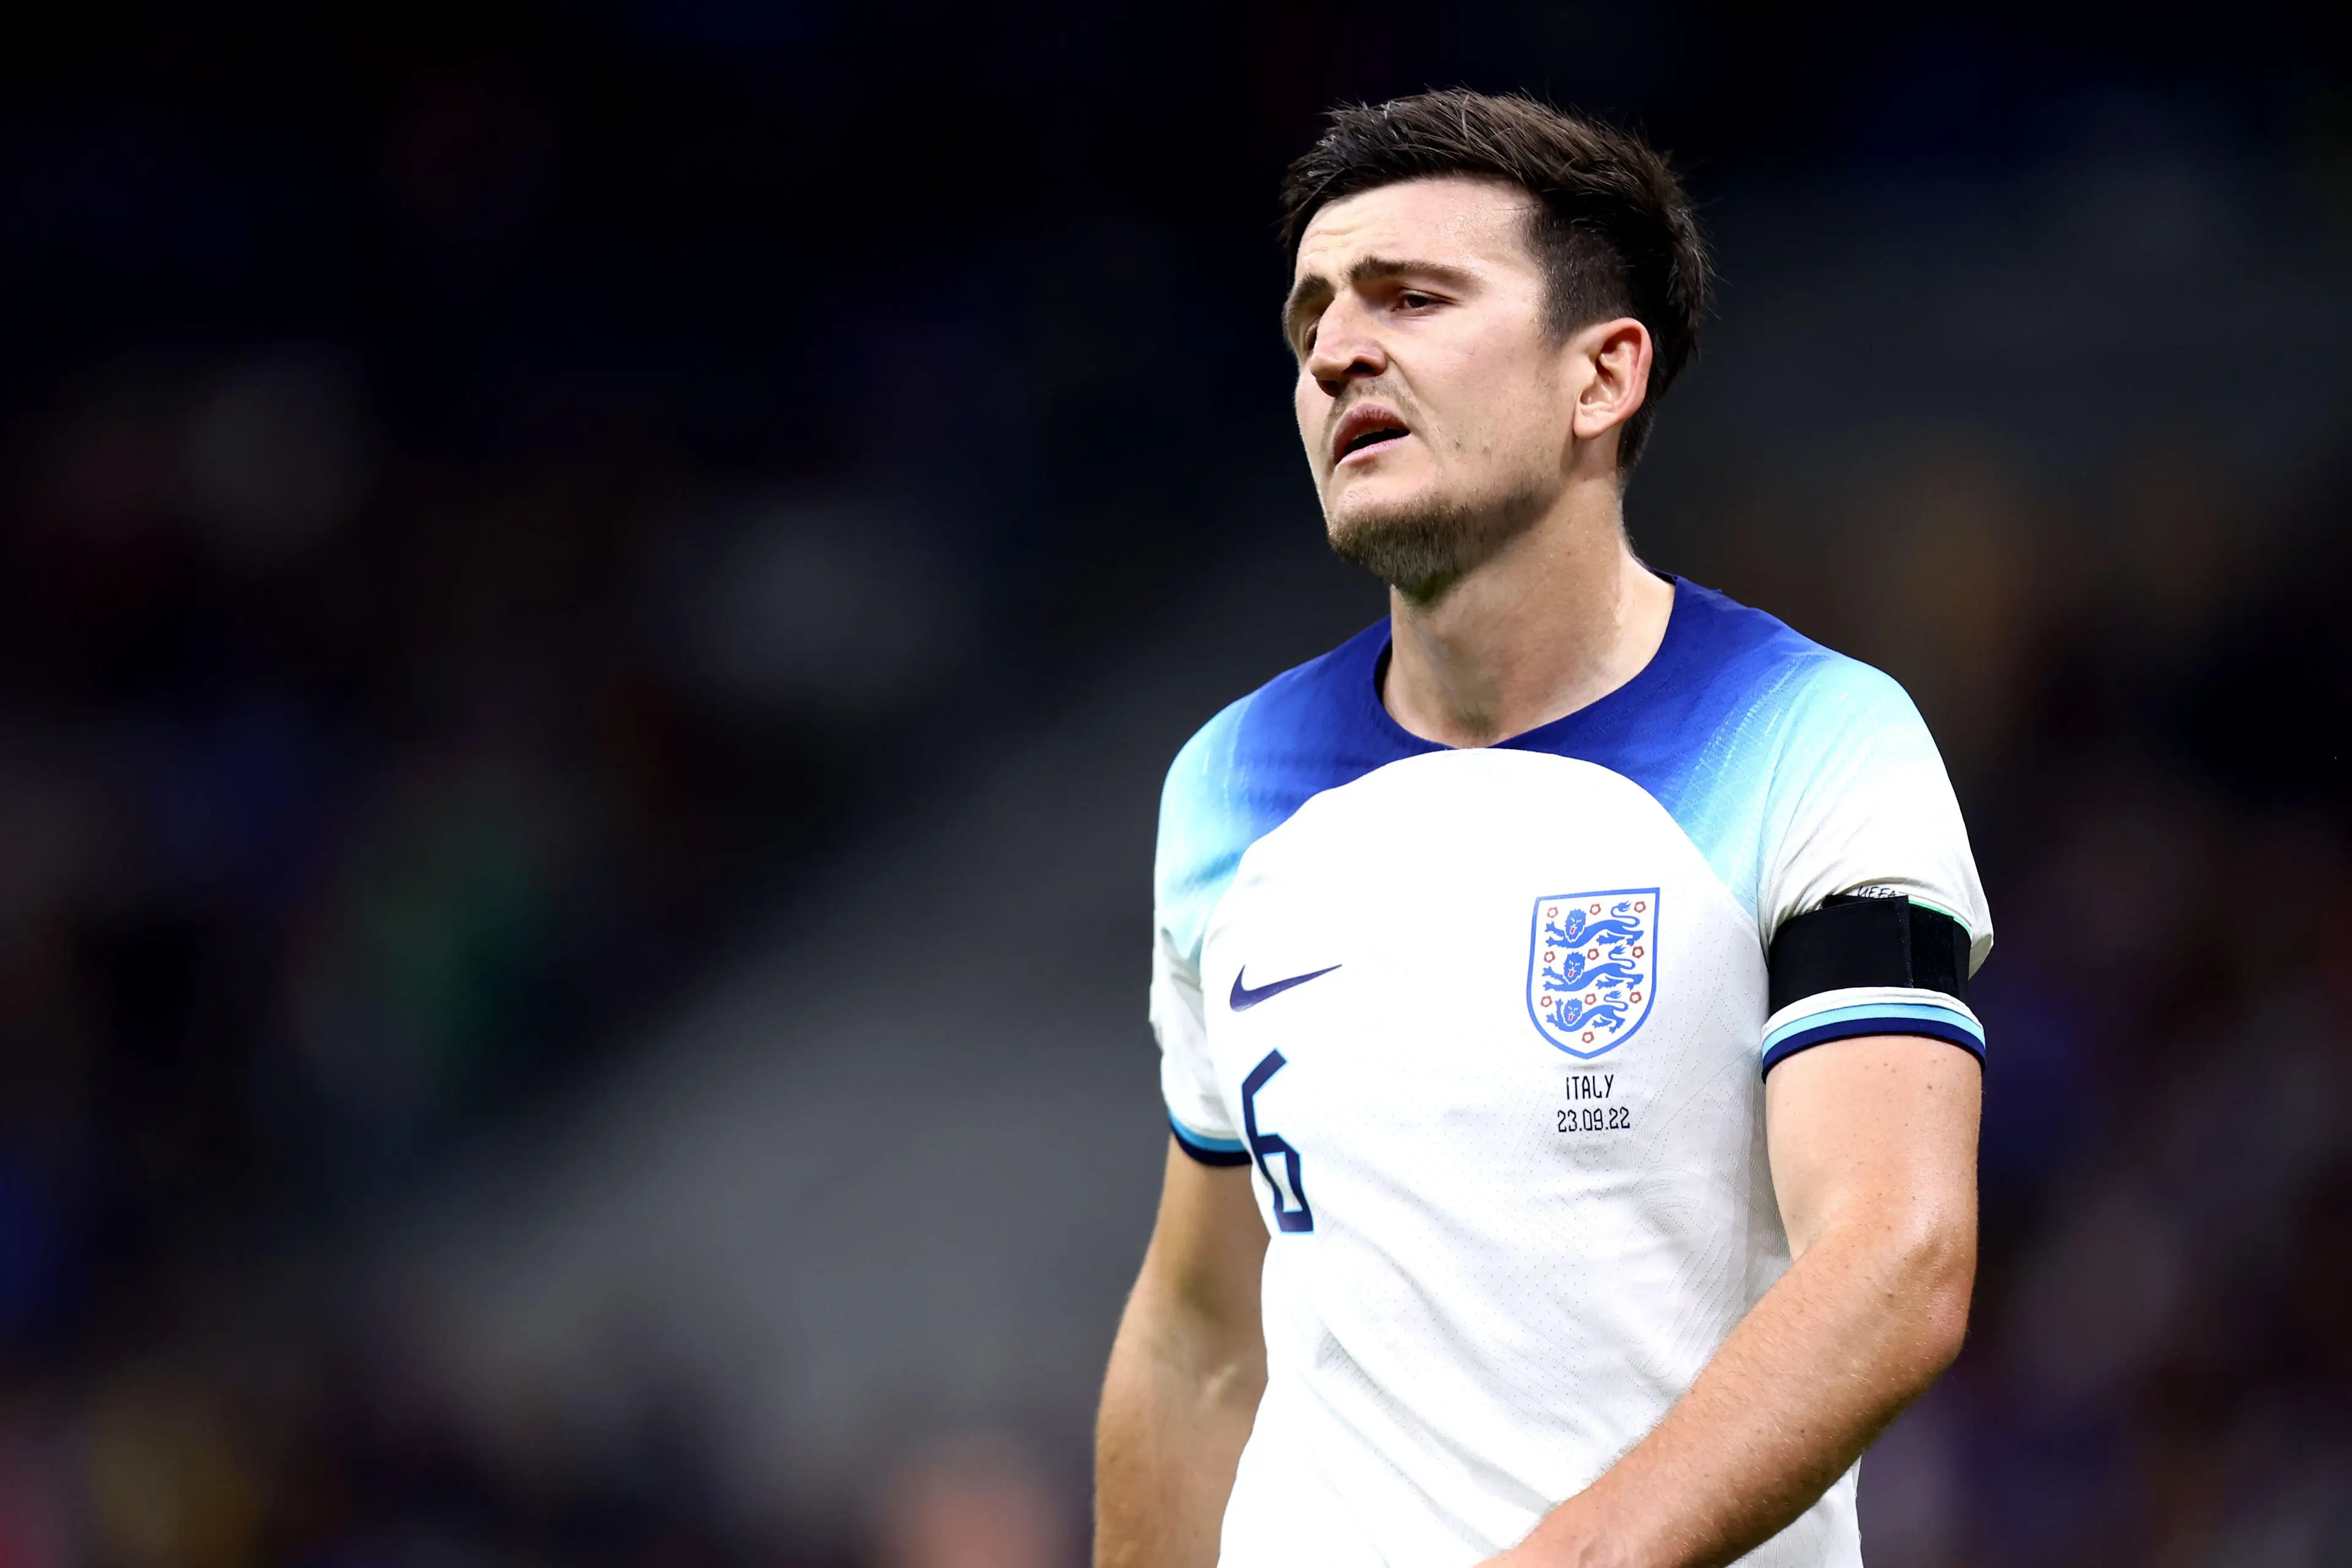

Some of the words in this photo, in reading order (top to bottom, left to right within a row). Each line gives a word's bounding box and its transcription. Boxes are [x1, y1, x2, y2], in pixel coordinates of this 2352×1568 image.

[1566, 1074, 1615, 1100] ITALY
[1557, 1106, 1630, 1133] 23.09.22
[1242, 1047, 1314, 1234] 6
